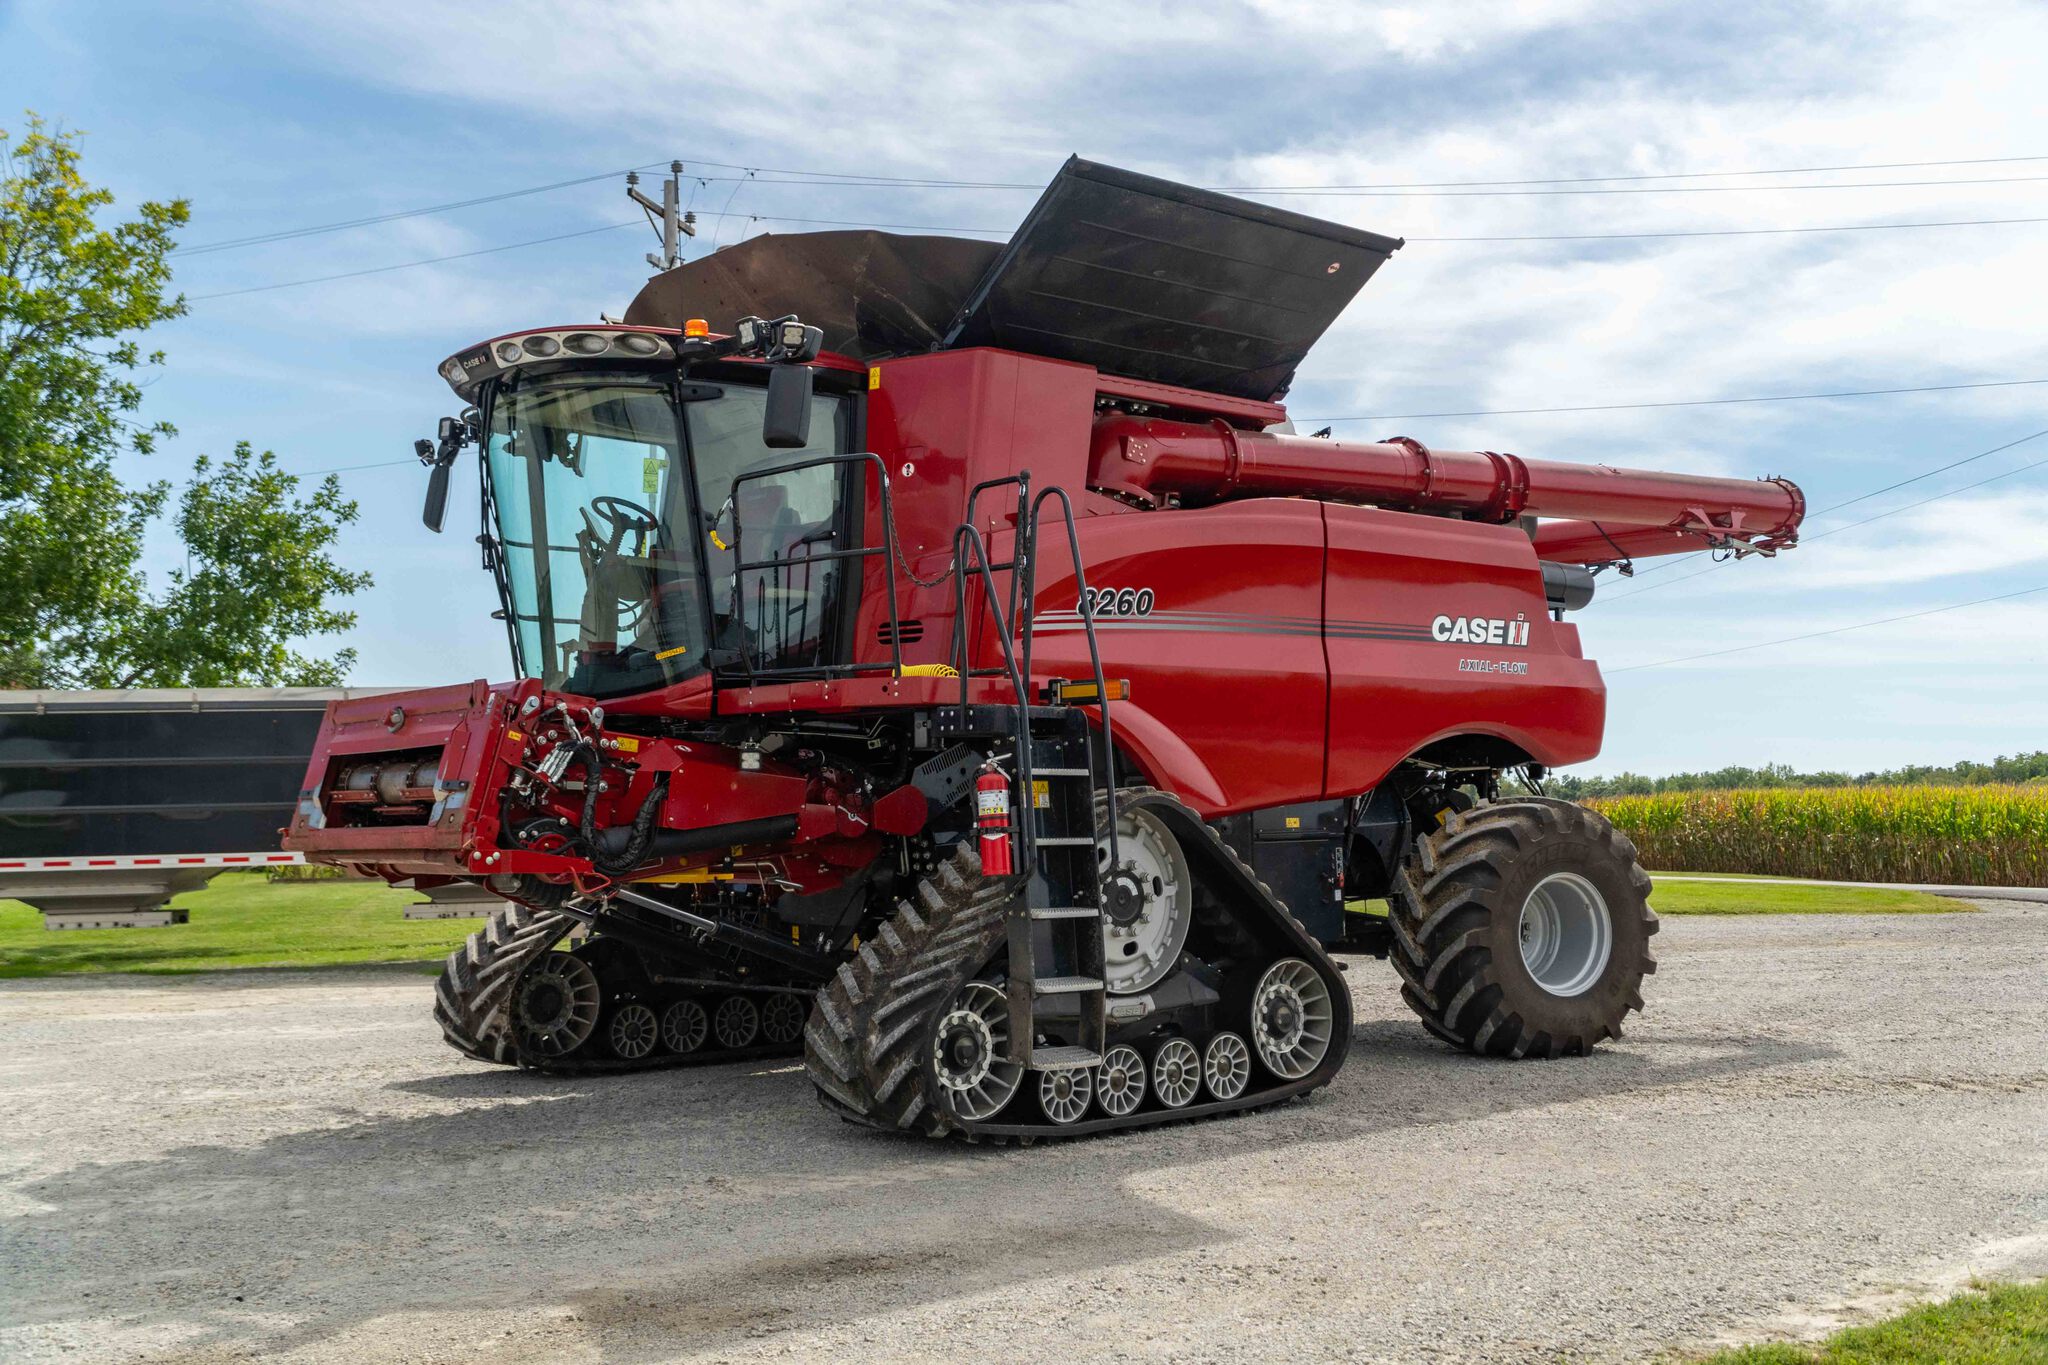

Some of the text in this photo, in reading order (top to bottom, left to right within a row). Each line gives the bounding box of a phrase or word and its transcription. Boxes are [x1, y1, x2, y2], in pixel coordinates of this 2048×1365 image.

[463, 358, 480, 369] CASE
[1077, 587, 1155, 617] 8260
[1432, 615, 1505, 644] CASE
[1459, 659, 1528, 675] AXIAL-FLOW
